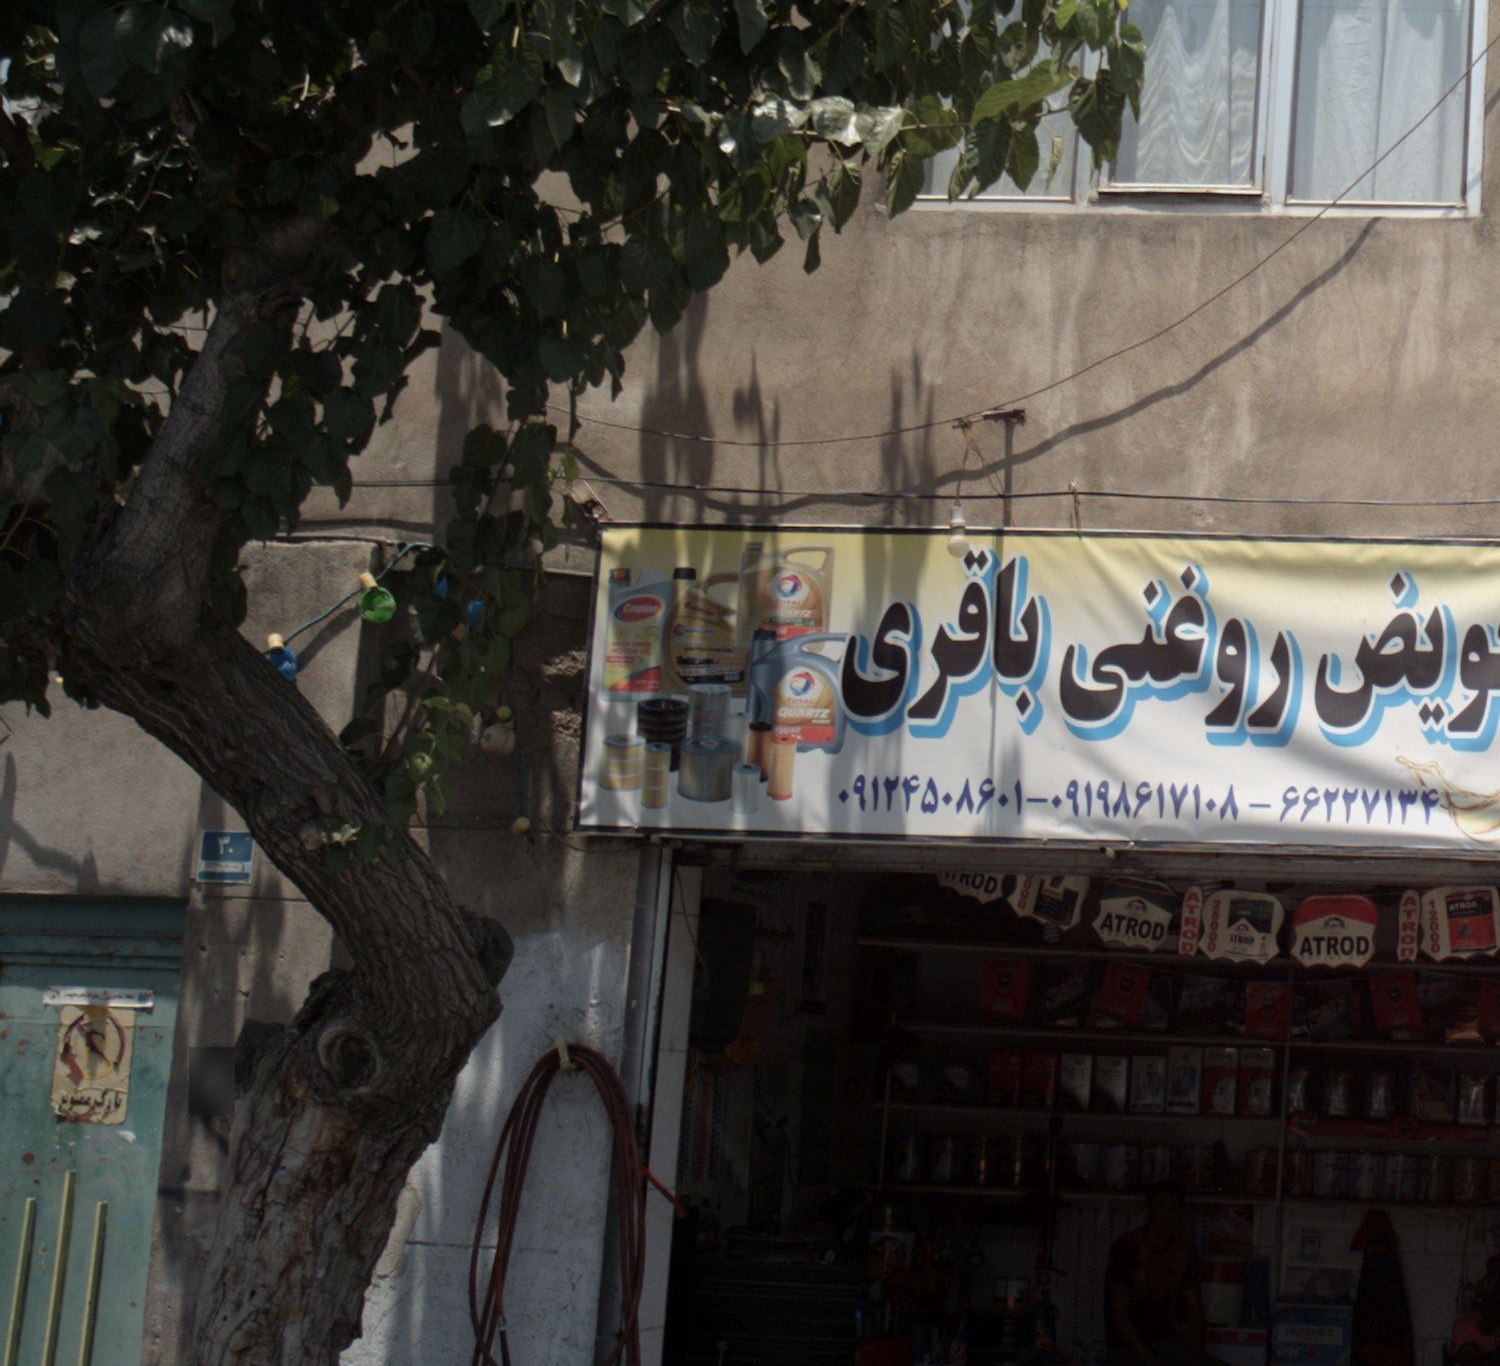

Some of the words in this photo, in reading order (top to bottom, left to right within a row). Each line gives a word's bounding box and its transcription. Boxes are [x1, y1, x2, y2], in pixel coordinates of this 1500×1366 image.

[843, 546, 1045, 730] باقری
[1059, 563, 1297, 736] روغنی
[778, 707, 831, 719] QUARTZ
[1279, 784, 1440, 827] ۶۶۲۲۷۱۳۴
[217, 835, 235, 856] ۳۰
[945, 872, 998, 896] ROD
[1180, 892, 1200, 954] ATROD
[1448, 900, 1478, 912] ATROD
[1100, 912, 1165, 942] ATROD
[1400, 896, 1418, 958] ATROD
[1428, 898, 1441, 954] 12000
[1300, 935, 1370, 957] ATROD
